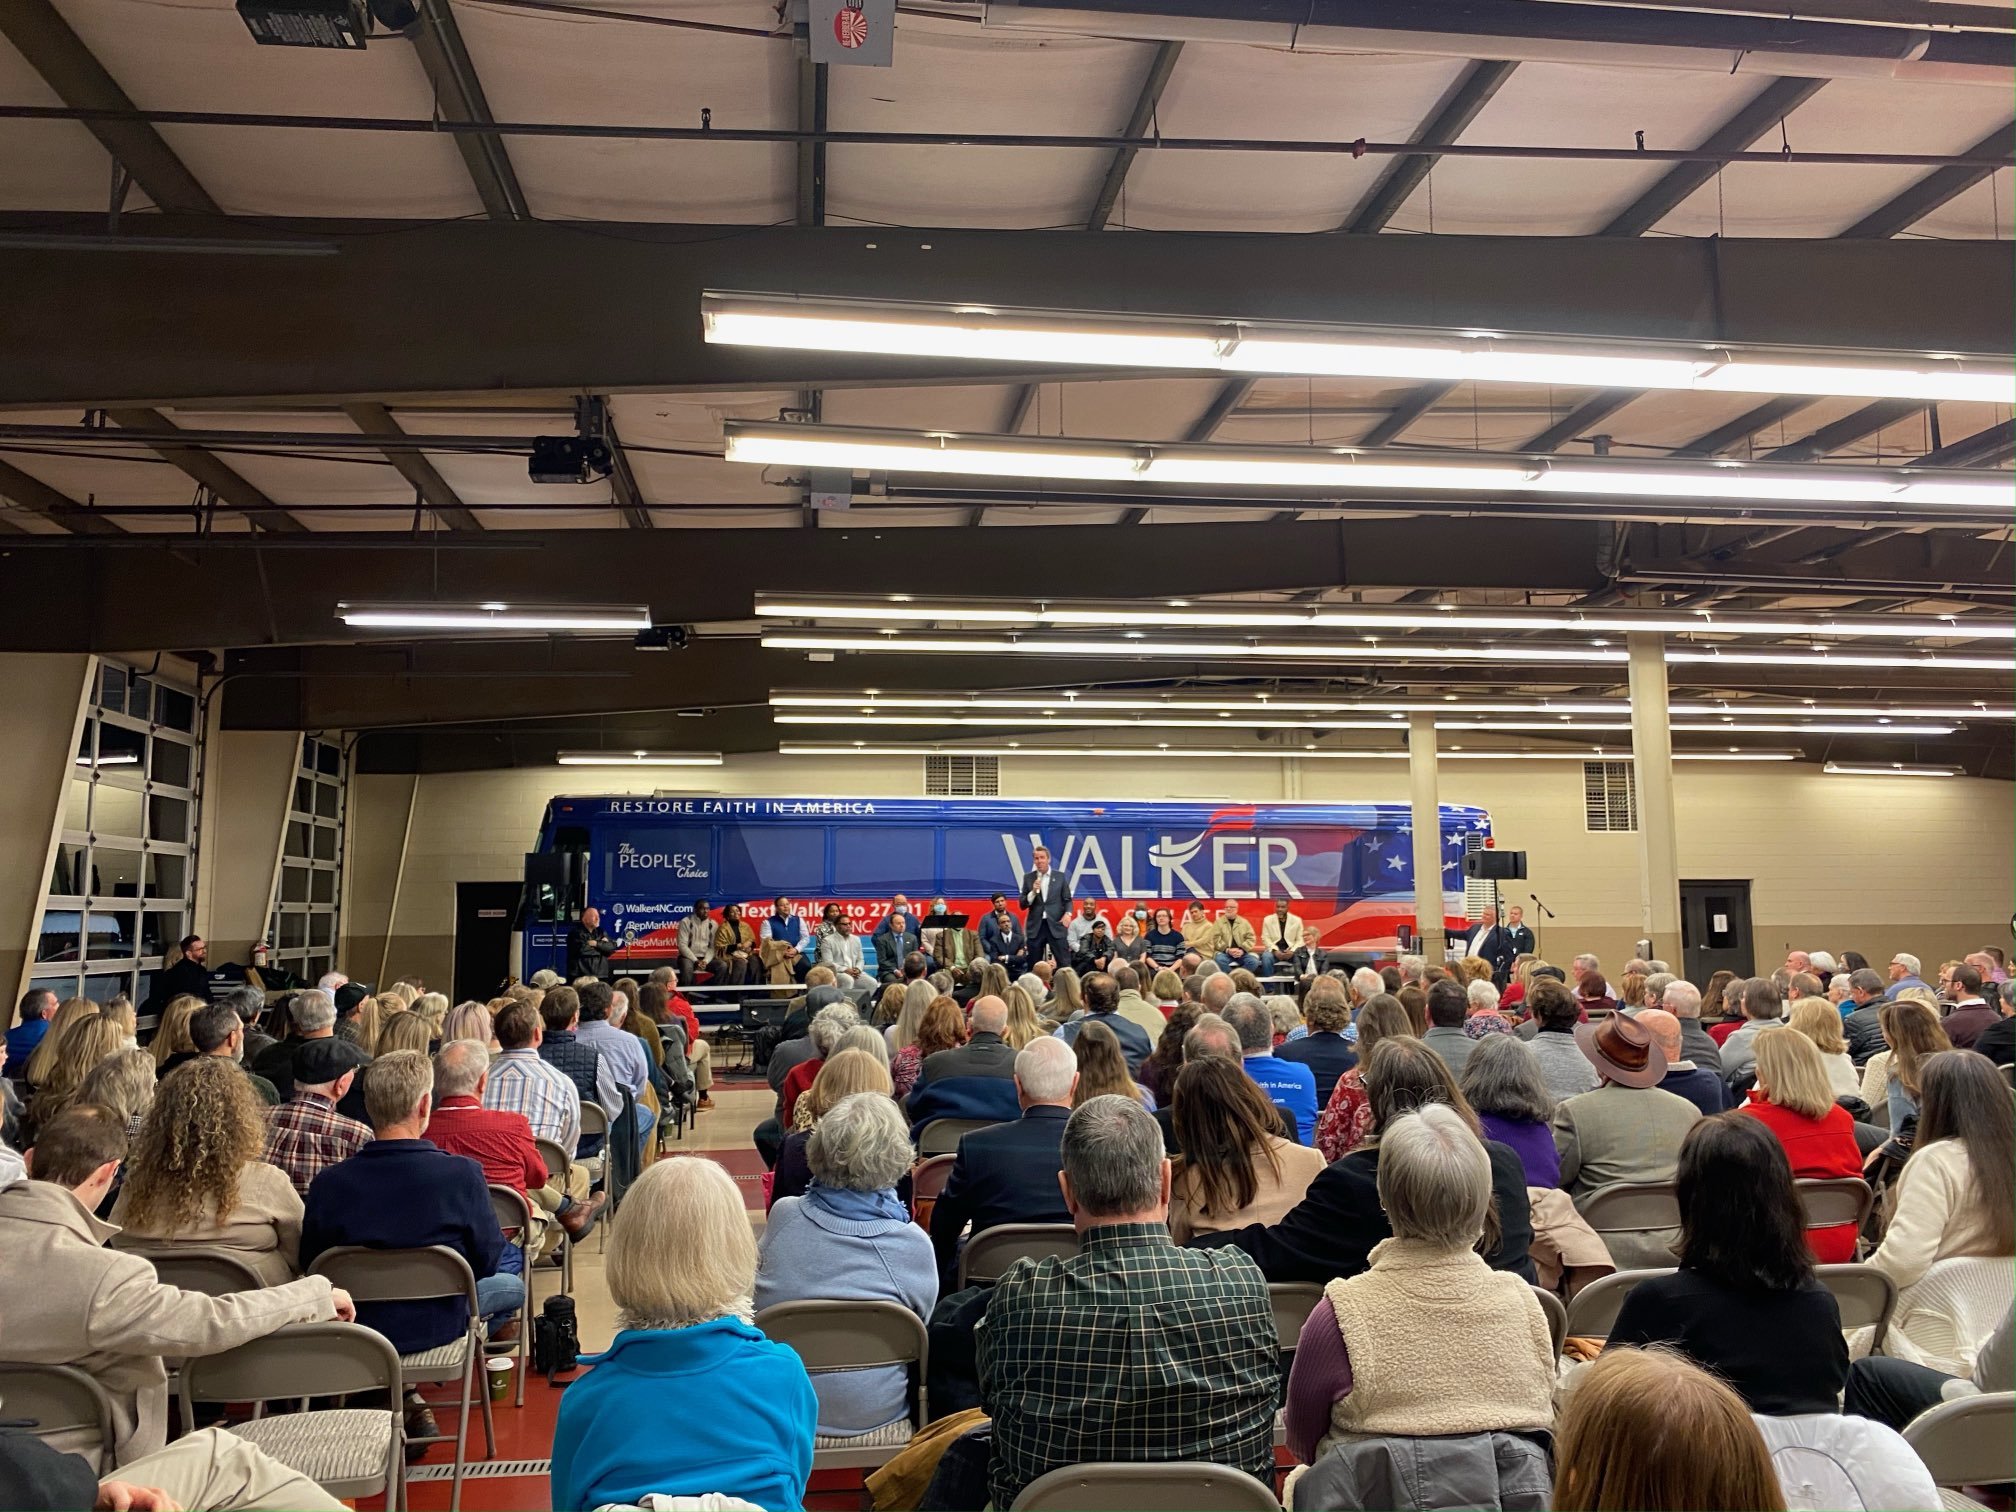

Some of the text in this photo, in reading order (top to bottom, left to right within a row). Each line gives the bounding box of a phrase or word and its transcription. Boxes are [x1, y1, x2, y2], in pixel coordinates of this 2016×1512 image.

[610, 801, 875, 814] RESTORE FAITH IN AMERICA
[618, 843, 635, 855] The
[619, 854, 696, 869] PEOPLE'S
[1001, 833, 1304, 900] WALKER
[676, 867, 708, 879] Choice
[625, 904, 694, 914] Walker4NC.com
[847, 904, 866, 917] to
[1269, 1081, 1277, 1089] in
[1277, 1082, 1302, 1090] America
